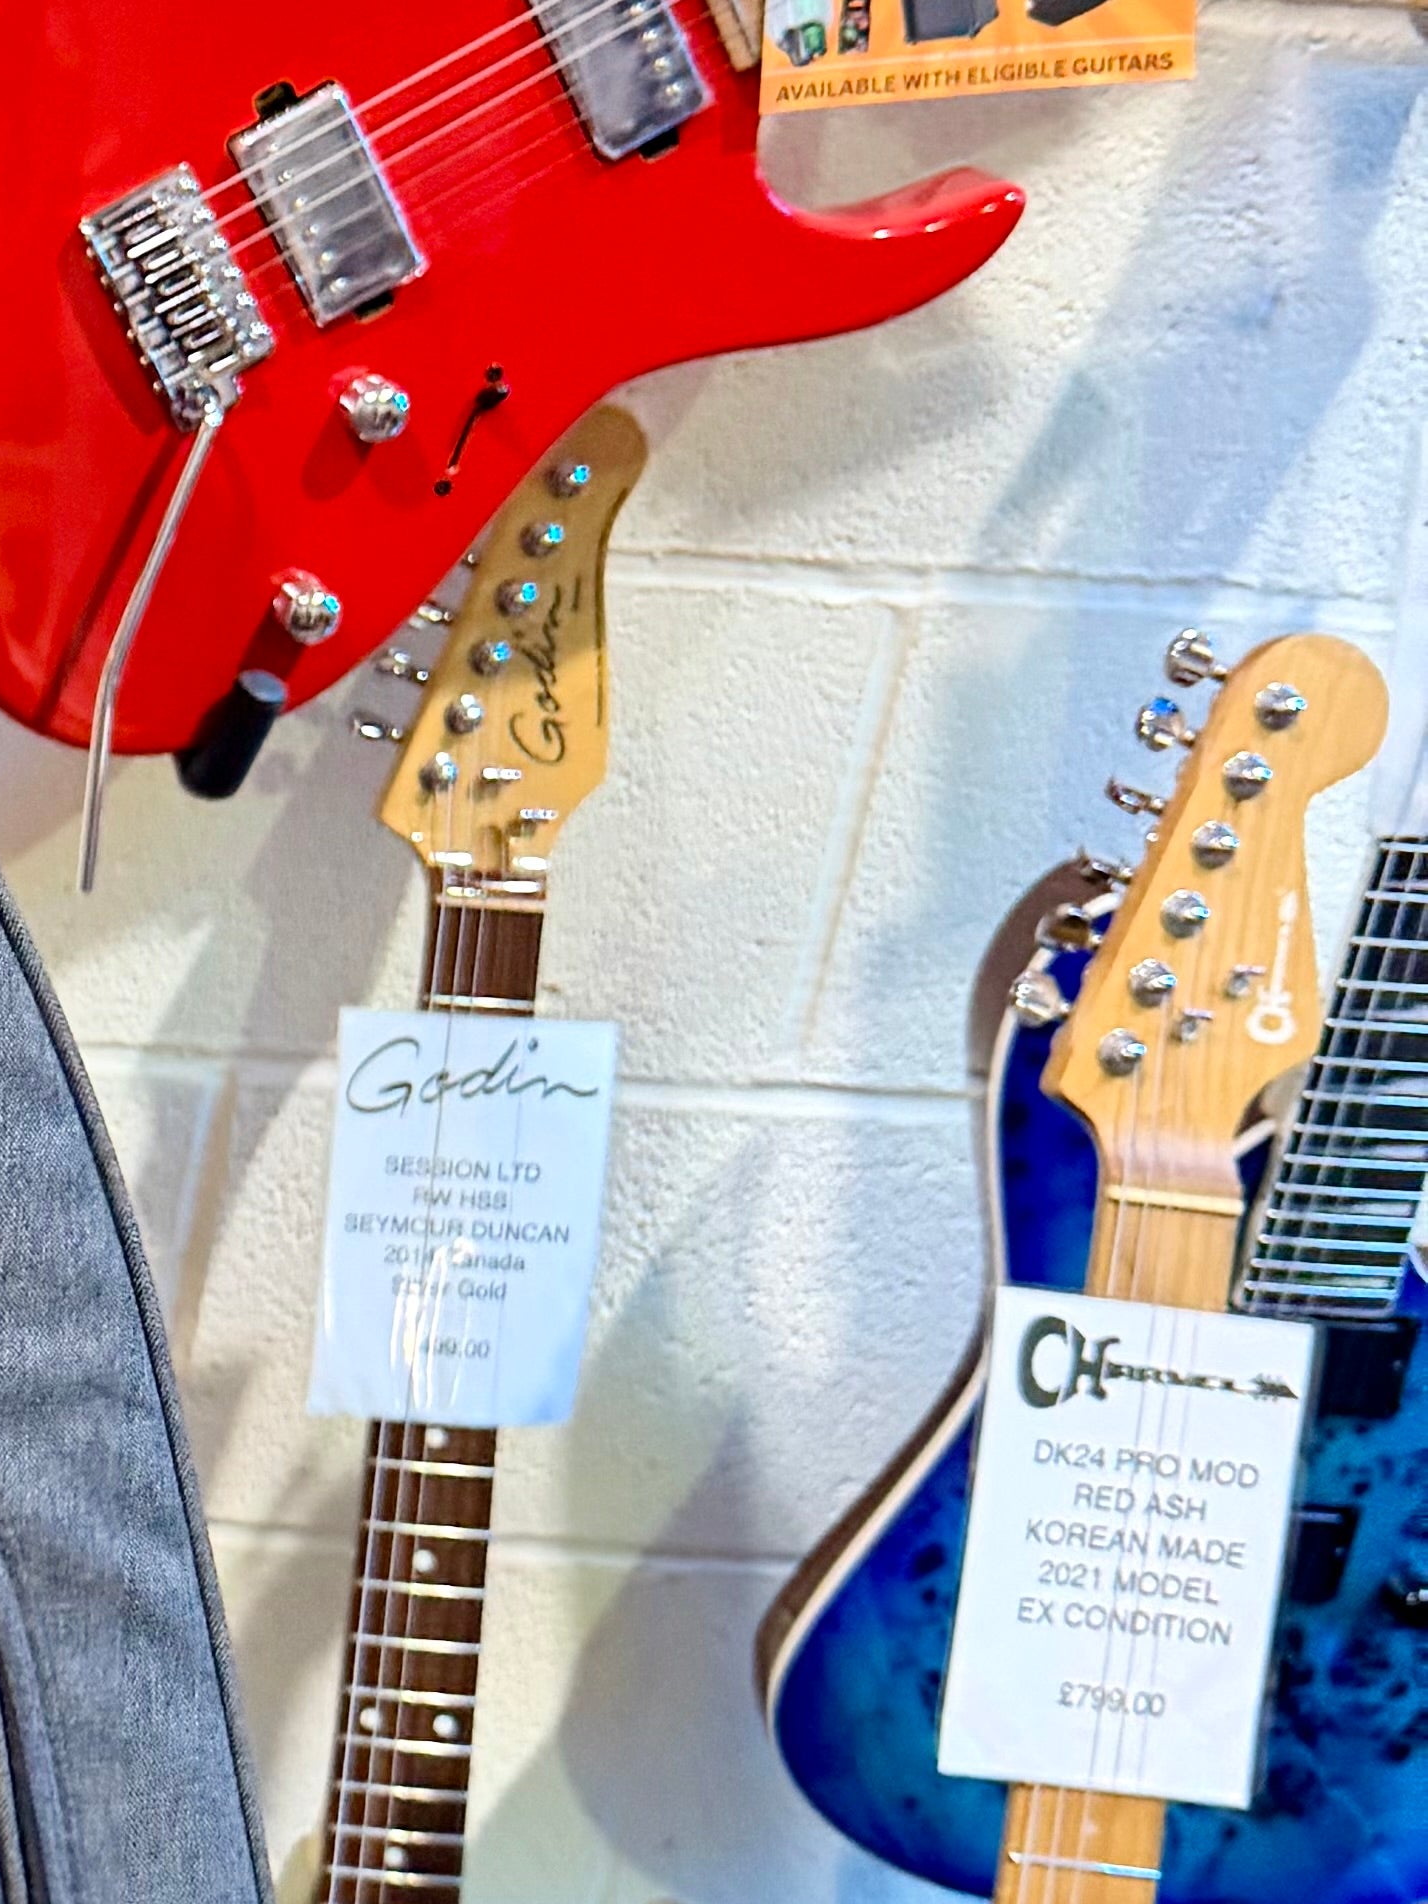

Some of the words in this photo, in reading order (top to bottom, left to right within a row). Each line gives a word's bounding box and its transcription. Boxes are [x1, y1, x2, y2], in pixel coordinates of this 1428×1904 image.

[776, 75, 895, 103] AVAILABLE
[904, 69, 961, 90] WITH
[967, 59, 1065, 84] ELIGIBLE
[1072, 51, 1174, 77] GUITARS
[346, 1036, 599, 1119] Godin
[385, 1155, 490, 1181] SESSION
[497, 1162, 541, 1183] LTD
[344, 1212, 464, 1238] SEYMOUR
[471, 1219, 570, 1245] DUNCAN
[458, 1278, 508, 1301] Gold
[1033, 1439, 1105, 1470] DK24
[1116, 1449, 1181, 1478] PRO
[1190, 1459, 1260, 1489] MOD
[1074, 1484, 1135, 1513] RED
[1145, 1492, 1207, 1522] ASH
[1026, 1519, 1149, 1555] KOREAN
[1158, 1536, 1247, 1570] MADE
[1039, 1560, 1101, 1590] 2021
[1114, 1573, 1220, 1606] MODEL
[1017, 1597, 1054, 1625] EX
[1063, 1604, 1232, 1646] CONDITION
[1056, 1682, 1166, 1718] £799.00
